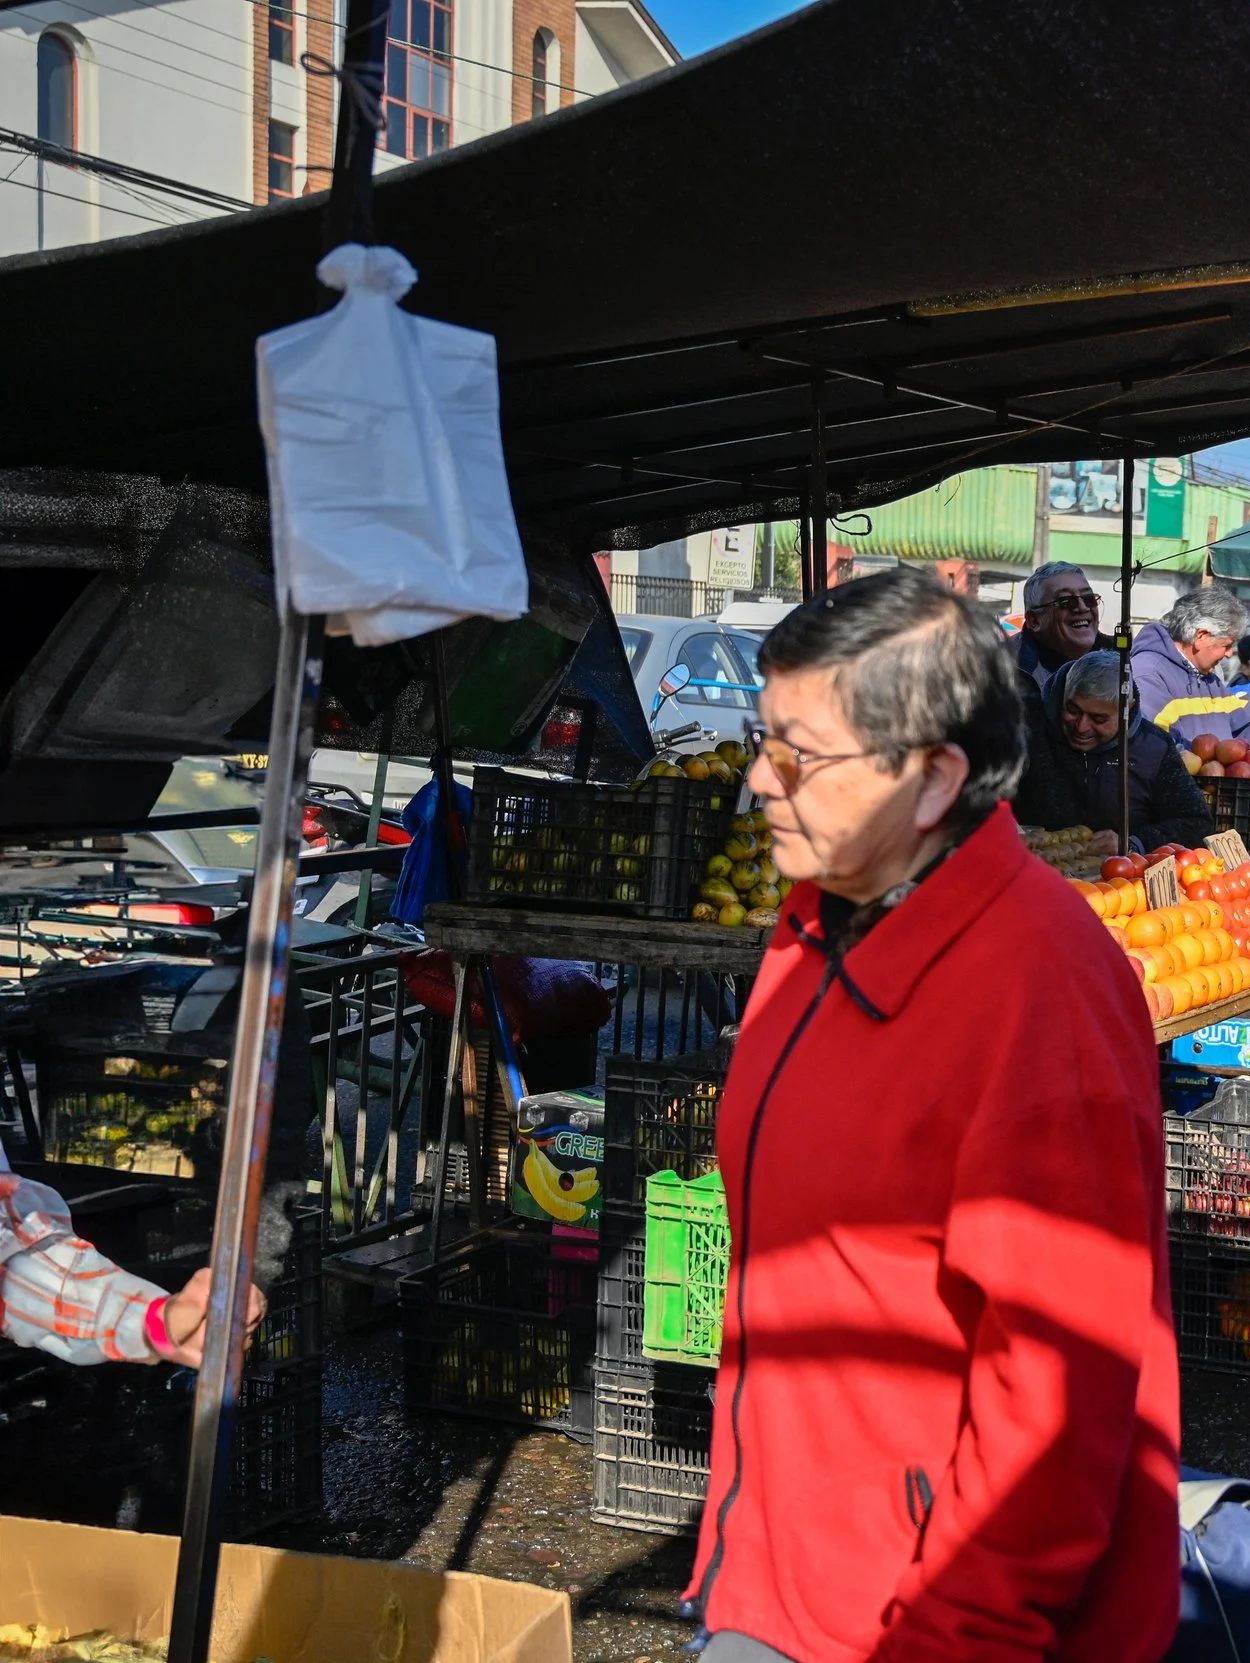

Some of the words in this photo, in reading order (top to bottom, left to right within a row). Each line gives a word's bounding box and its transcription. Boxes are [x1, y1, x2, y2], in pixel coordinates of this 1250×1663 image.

[715, 560, 747, 569] EXCEPTO
[712, 568, 748, 578] SERVICIOS
[709, 577, 750, 586] RELIGIOSOS
